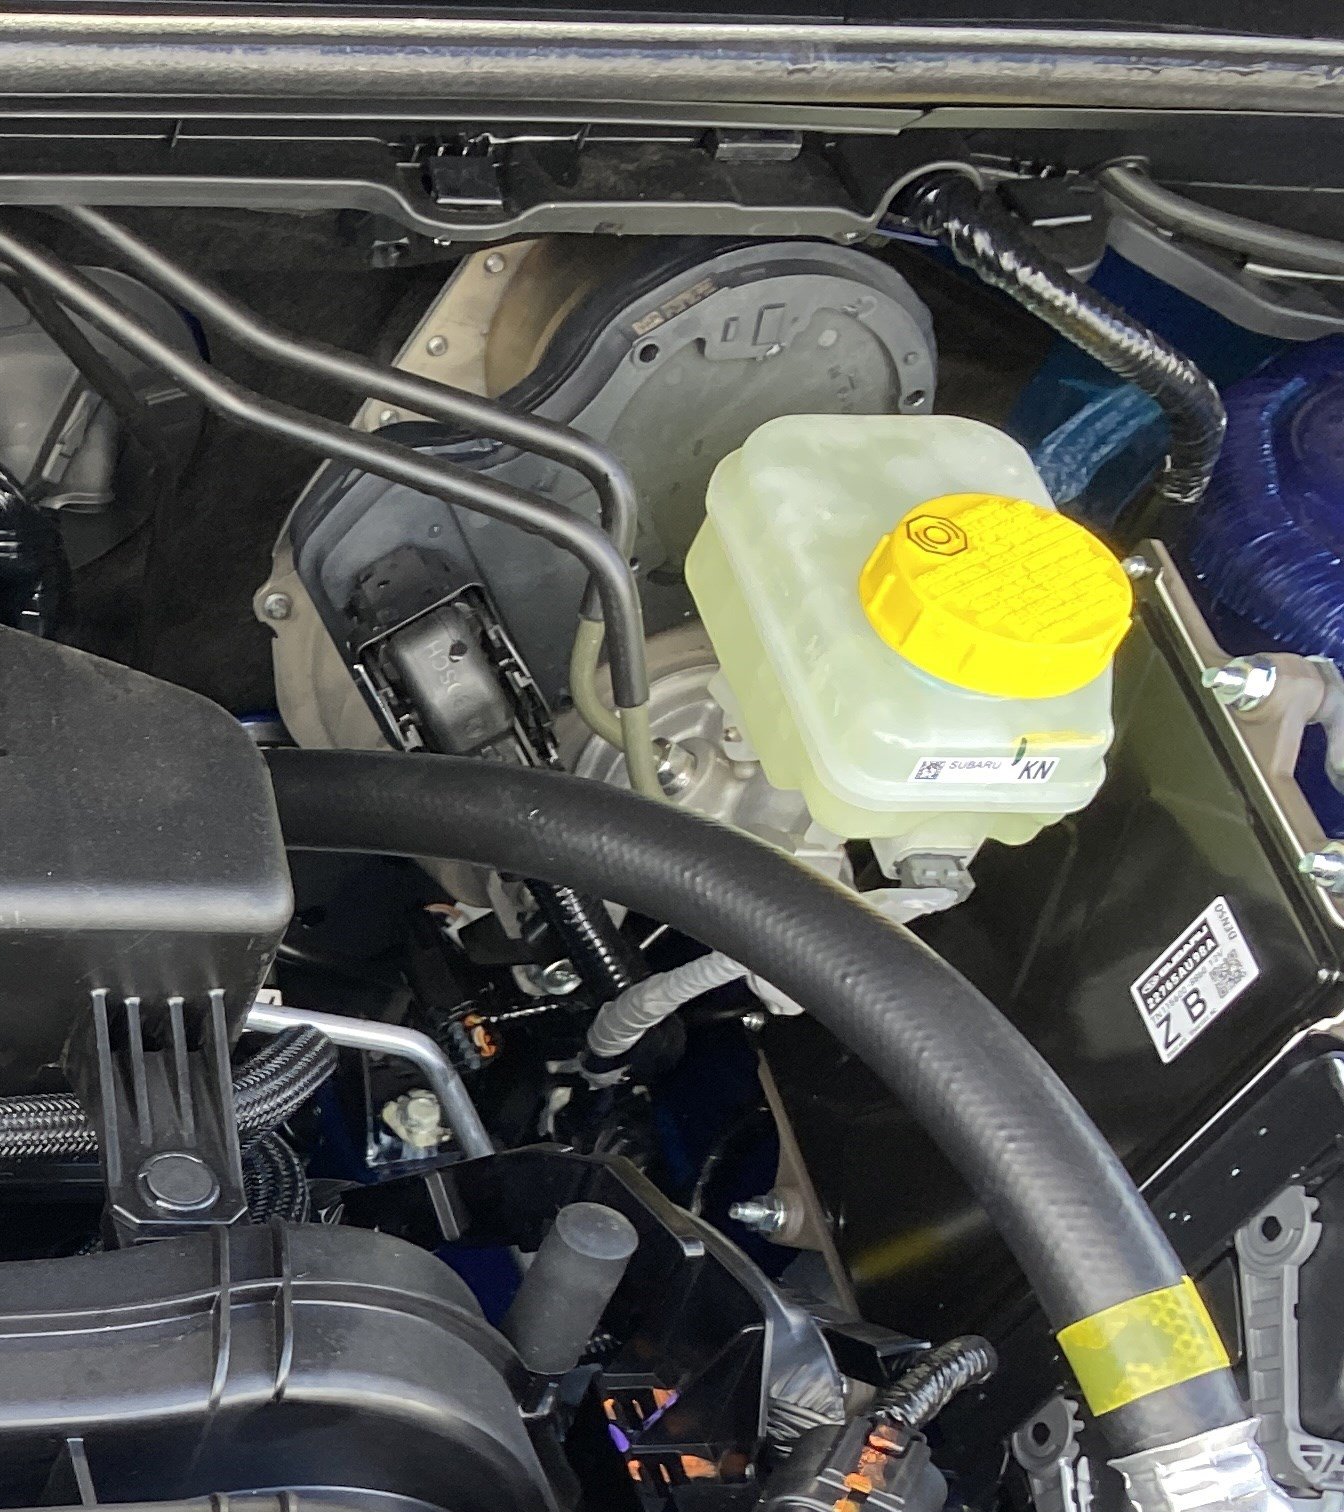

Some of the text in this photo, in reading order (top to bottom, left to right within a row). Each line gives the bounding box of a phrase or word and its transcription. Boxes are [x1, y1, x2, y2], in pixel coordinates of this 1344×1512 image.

[949, 760, 1055, 779] SUBARU KN
[1213, 901, 1238, 942] DENSO
[1157, 923, 1208, 979] SUBARU
[1154, 1011, 1181, 1050] Z
[1181, 983, 1209, 1023] B
